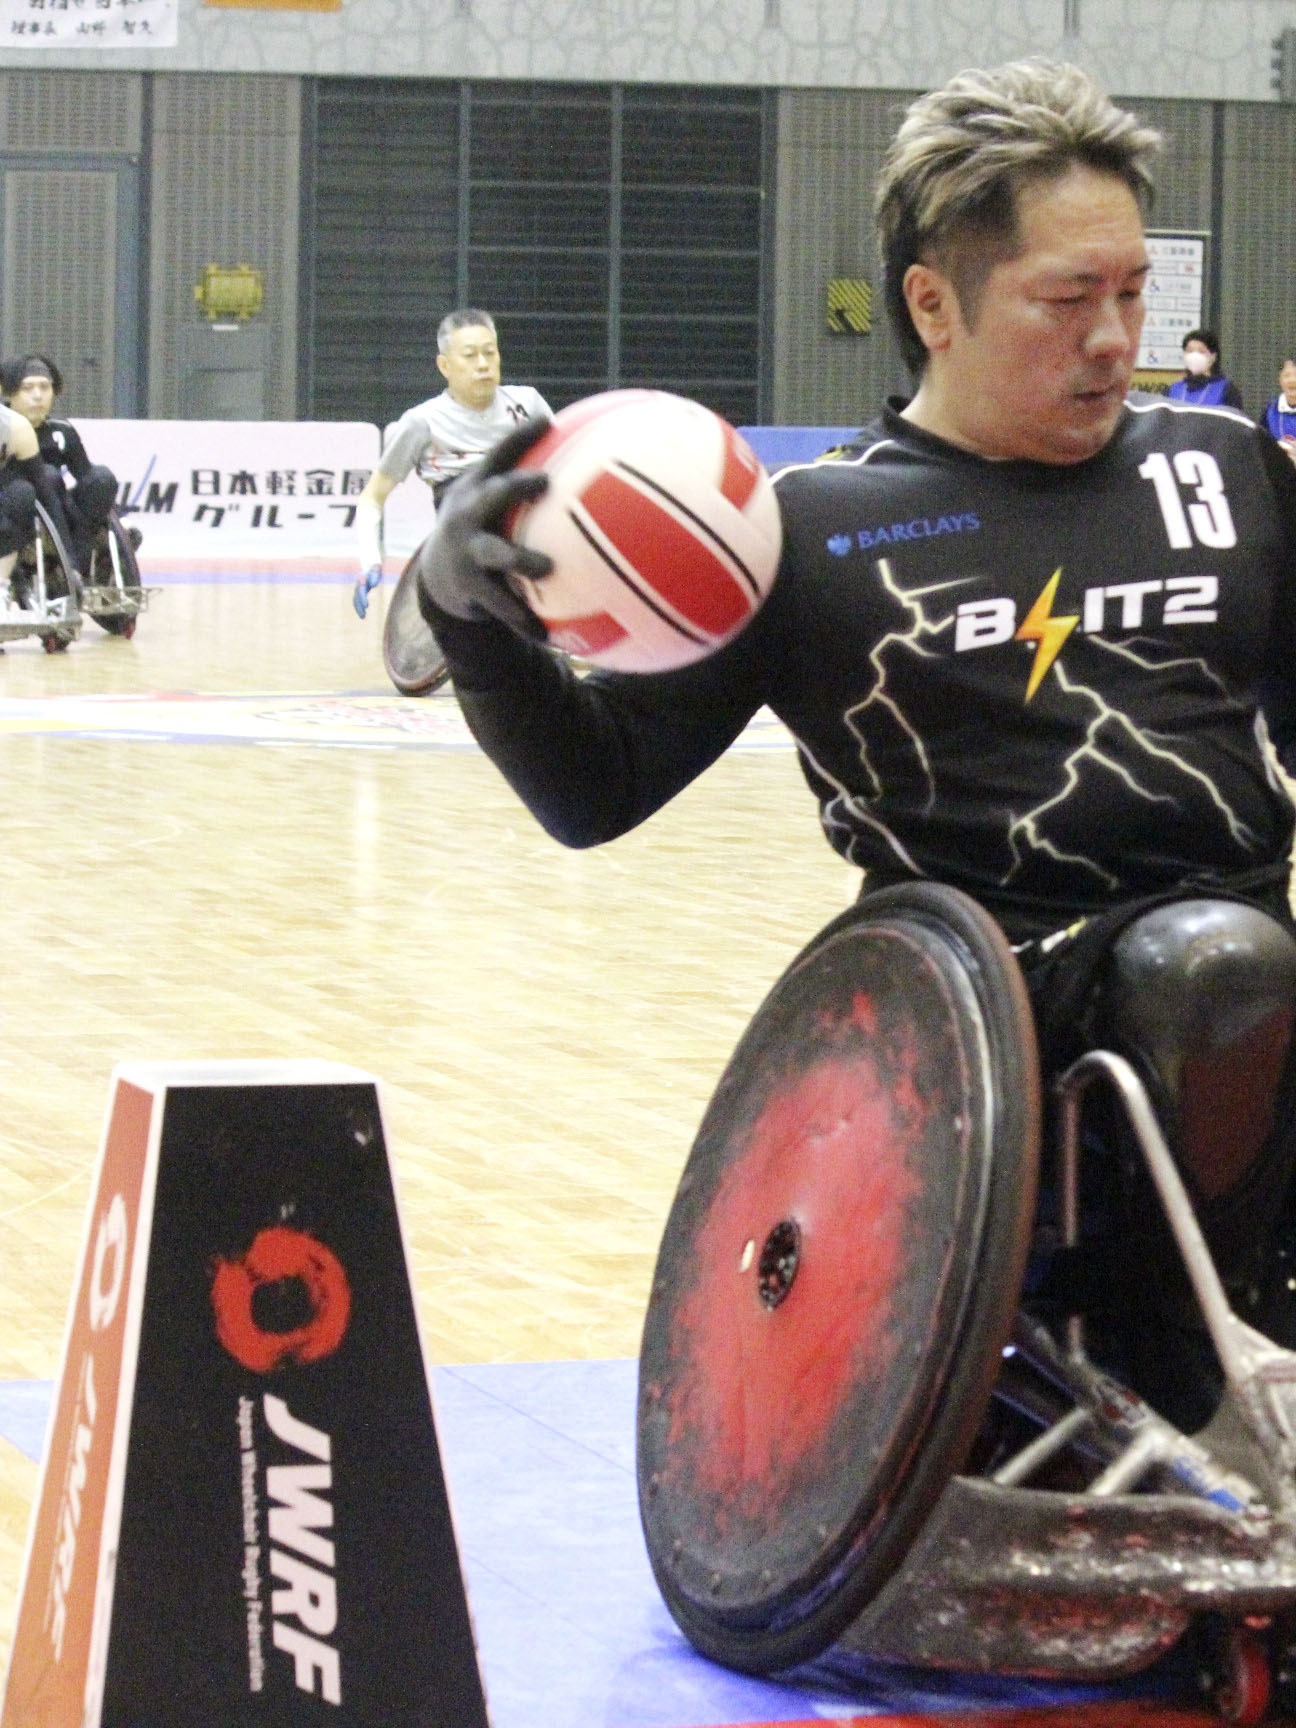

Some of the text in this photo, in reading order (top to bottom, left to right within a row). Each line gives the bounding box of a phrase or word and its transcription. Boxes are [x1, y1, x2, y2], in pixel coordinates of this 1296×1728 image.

[857, 512, 981, 549] BARCLAYS
[1139, 451, 1237, 549] 13
[262, 1393, 341, 1706] JWRF
